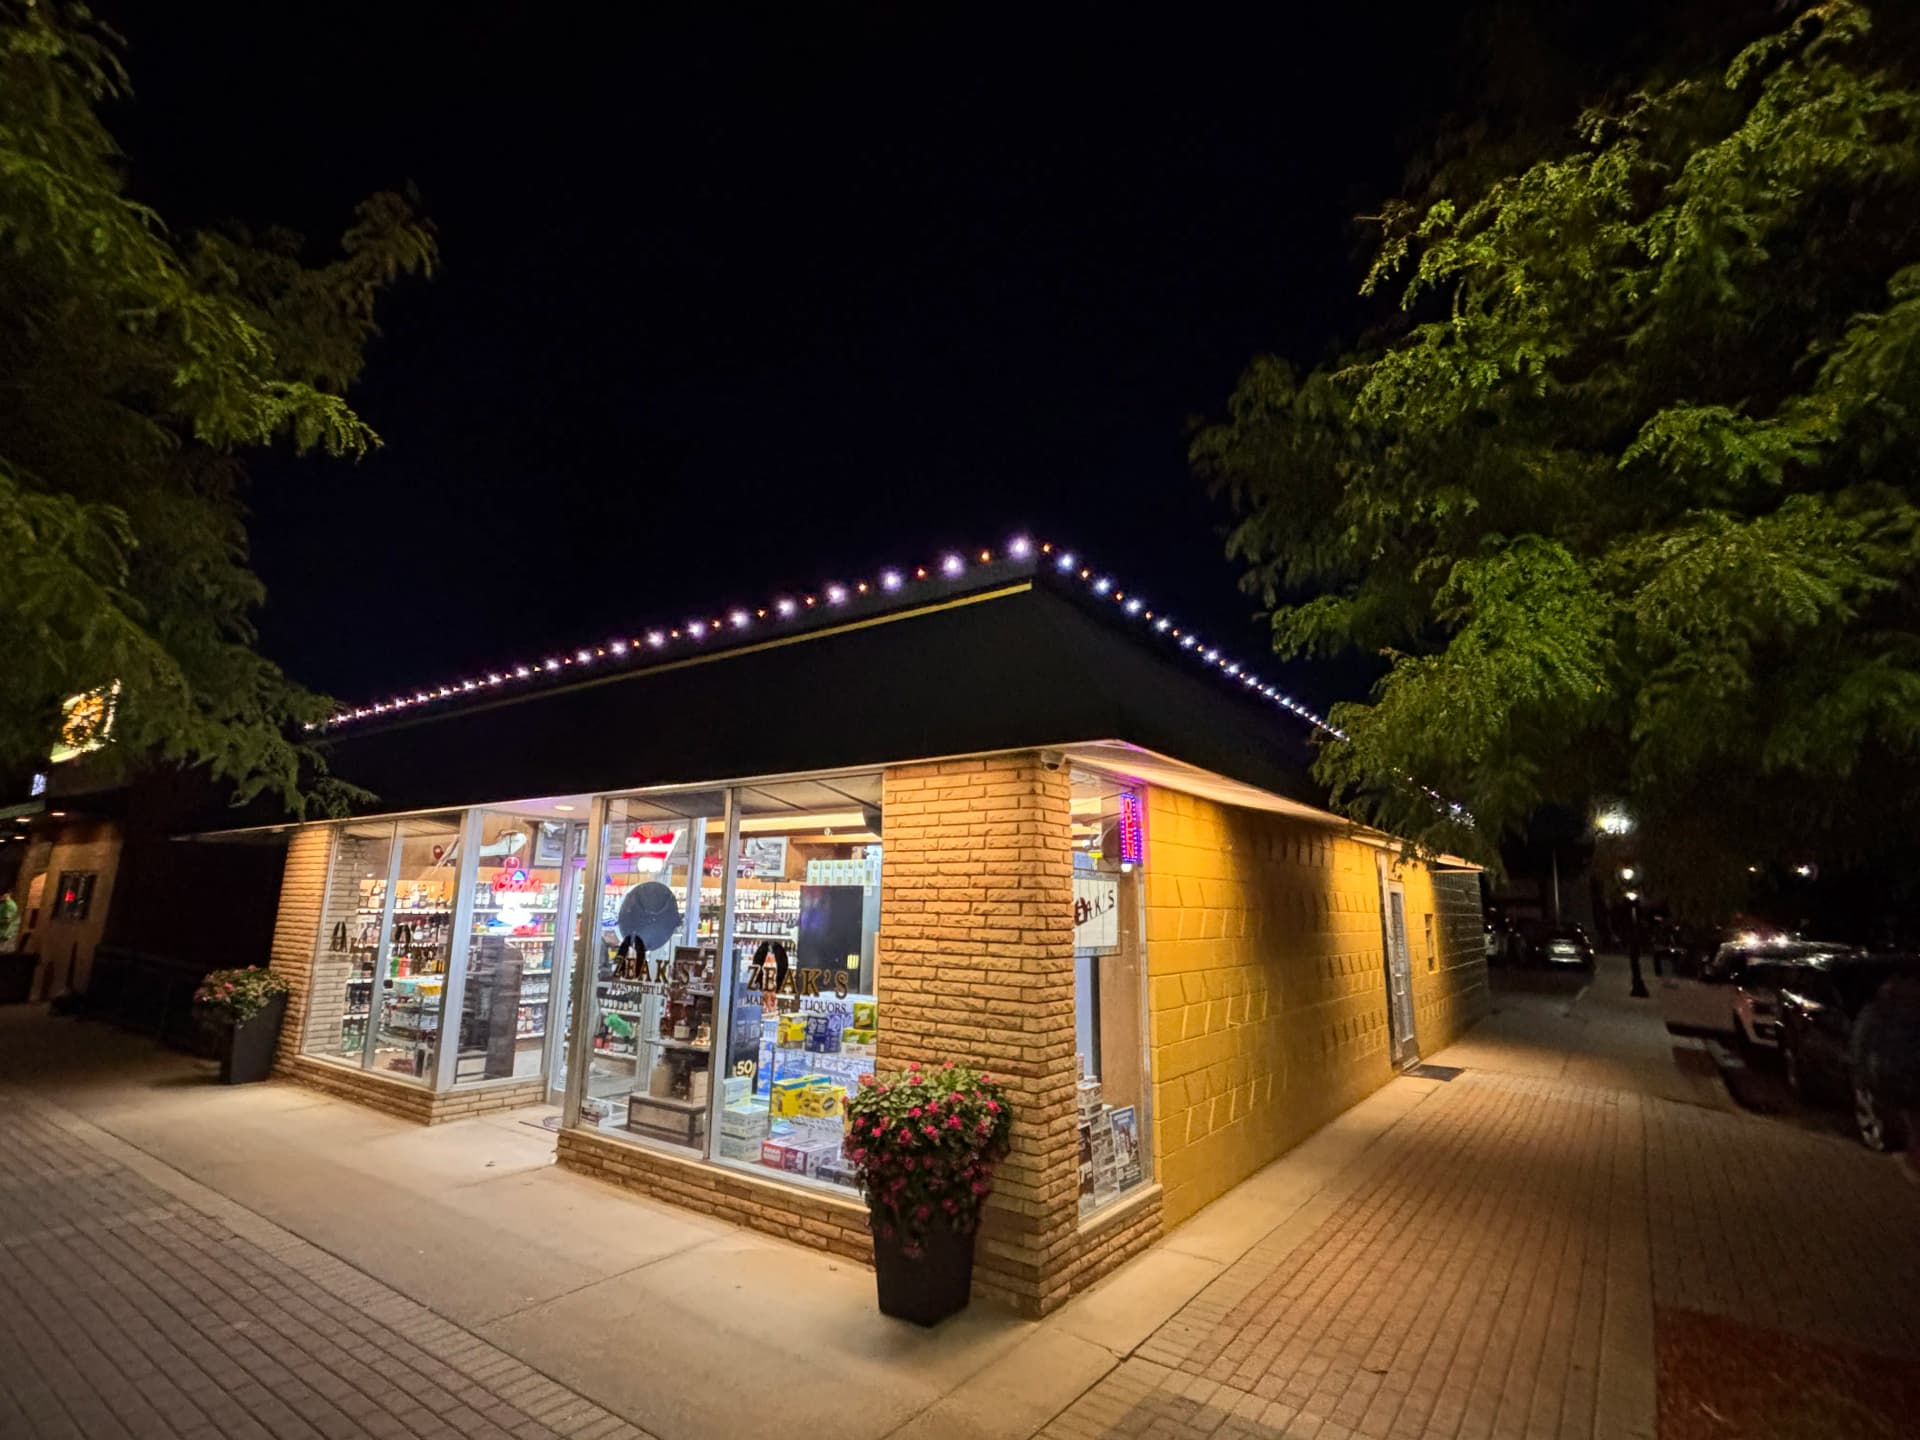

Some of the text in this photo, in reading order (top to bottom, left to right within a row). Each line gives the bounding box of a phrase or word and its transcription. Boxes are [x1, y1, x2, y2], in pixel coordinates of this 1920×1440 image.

[1124, 797, 1135, 859] OPEN
[1075, 889, 1115, 925] EAK'S
[746, 963, 849, 999] ZEAK'S
[805, 999, 847, 1015] LIQUORS
[736, 1059, 753, 1076] 50
